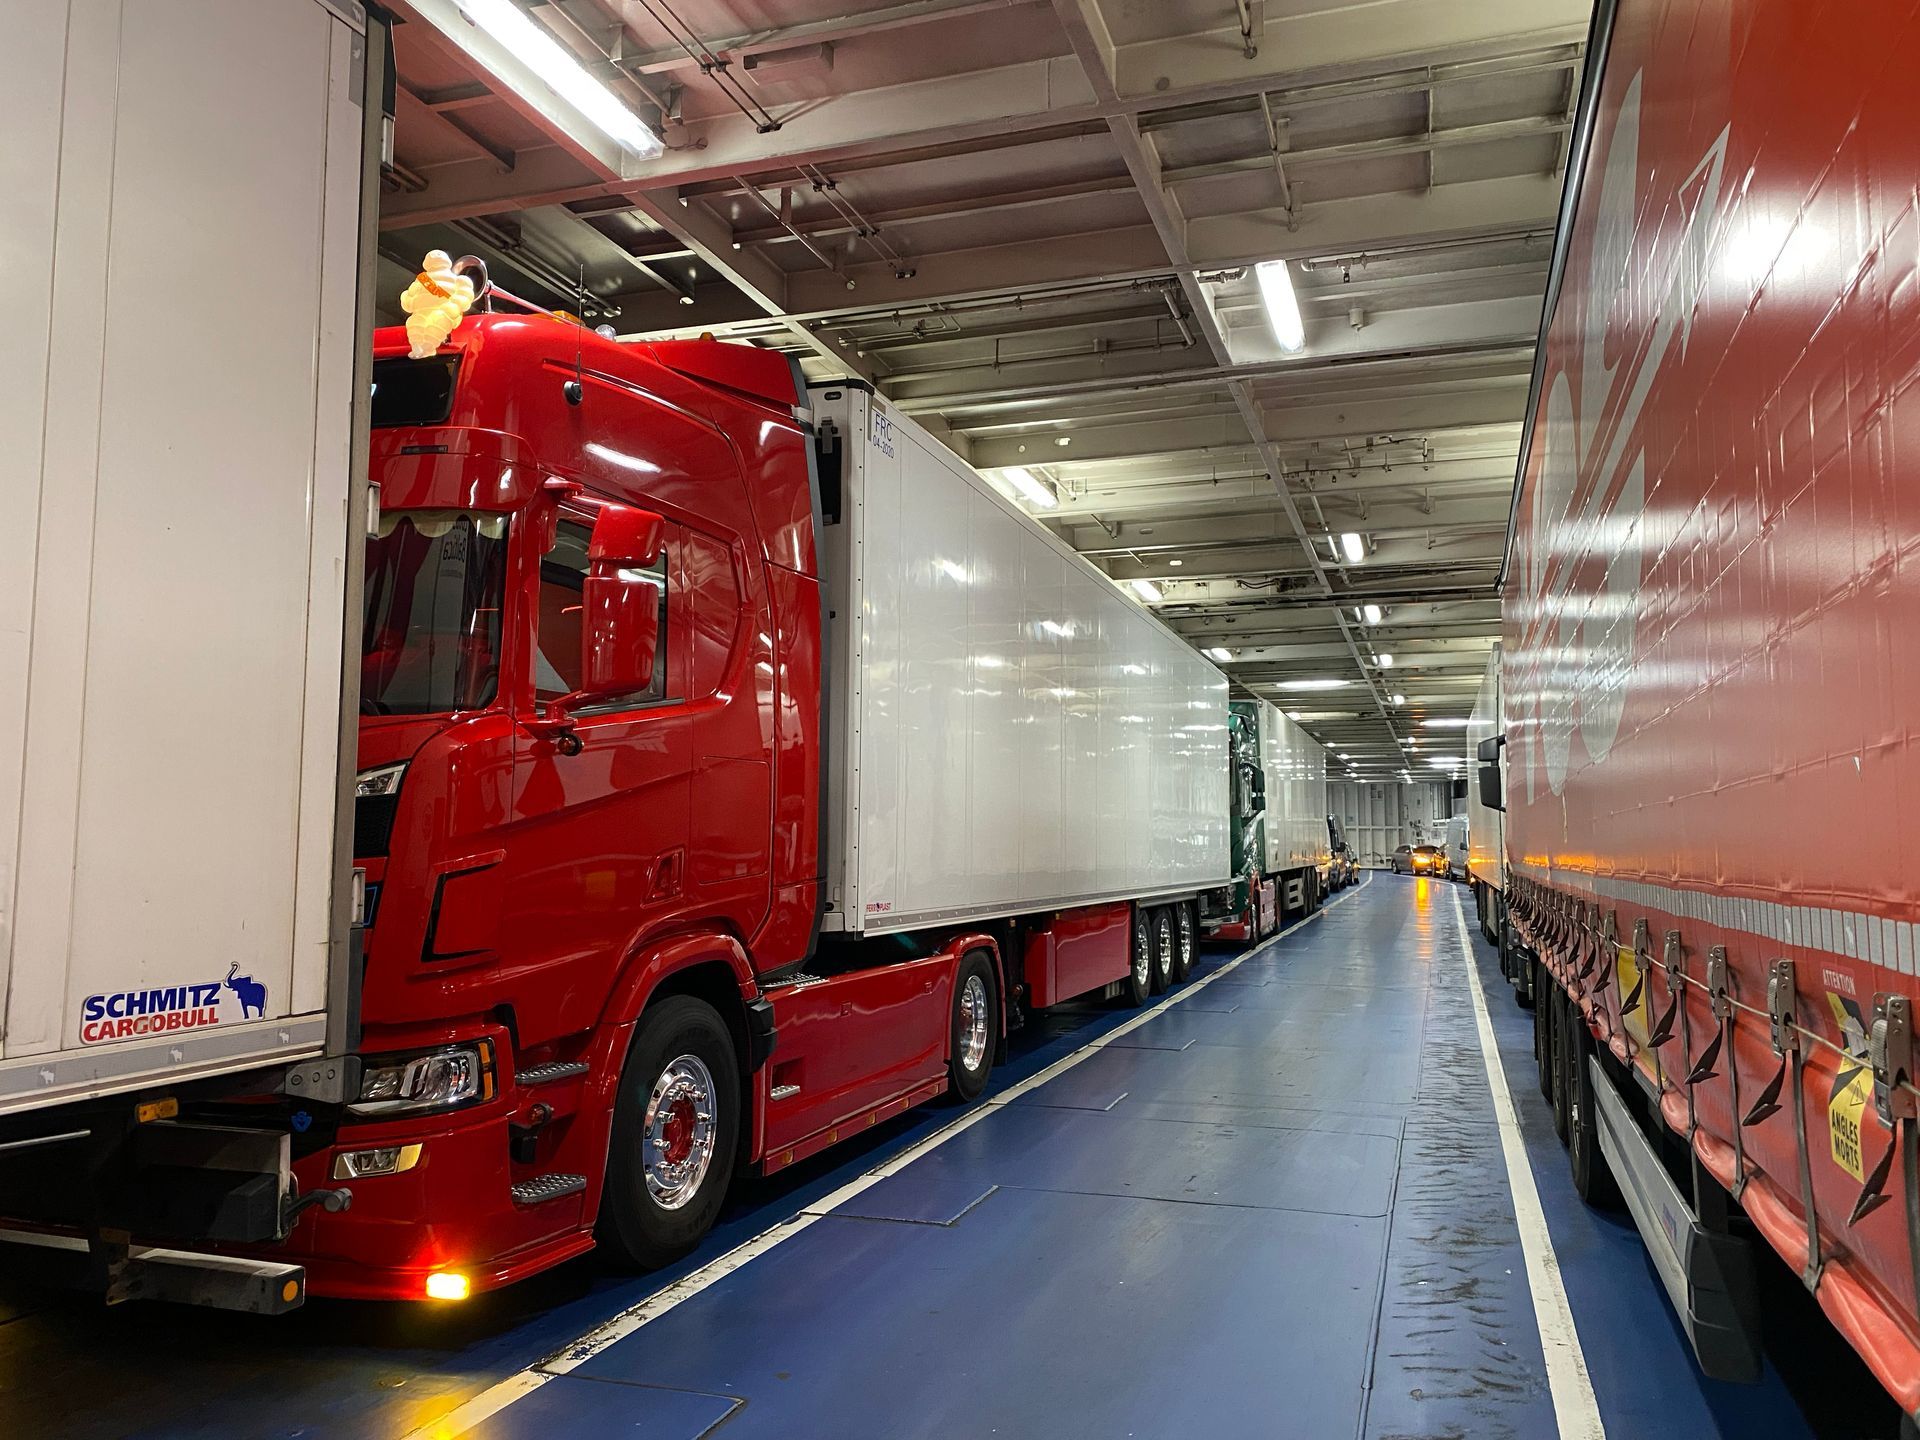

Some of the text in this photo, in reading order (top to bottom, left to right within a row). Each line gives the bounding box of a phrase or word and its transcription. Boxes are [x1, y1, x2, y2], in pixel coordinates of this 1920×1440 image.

[875, 413, 893, 442] FRC
[1822, 968, 1856, 996] ATTENTION
[85, 983, 222, 1021] SCHMITZ
[83, 1008, 219, 1042] CARGOBULL
[1831, 1109, 1859, 1146] ANGLES
[1834, 1139, 1860, 1172] MORTS
